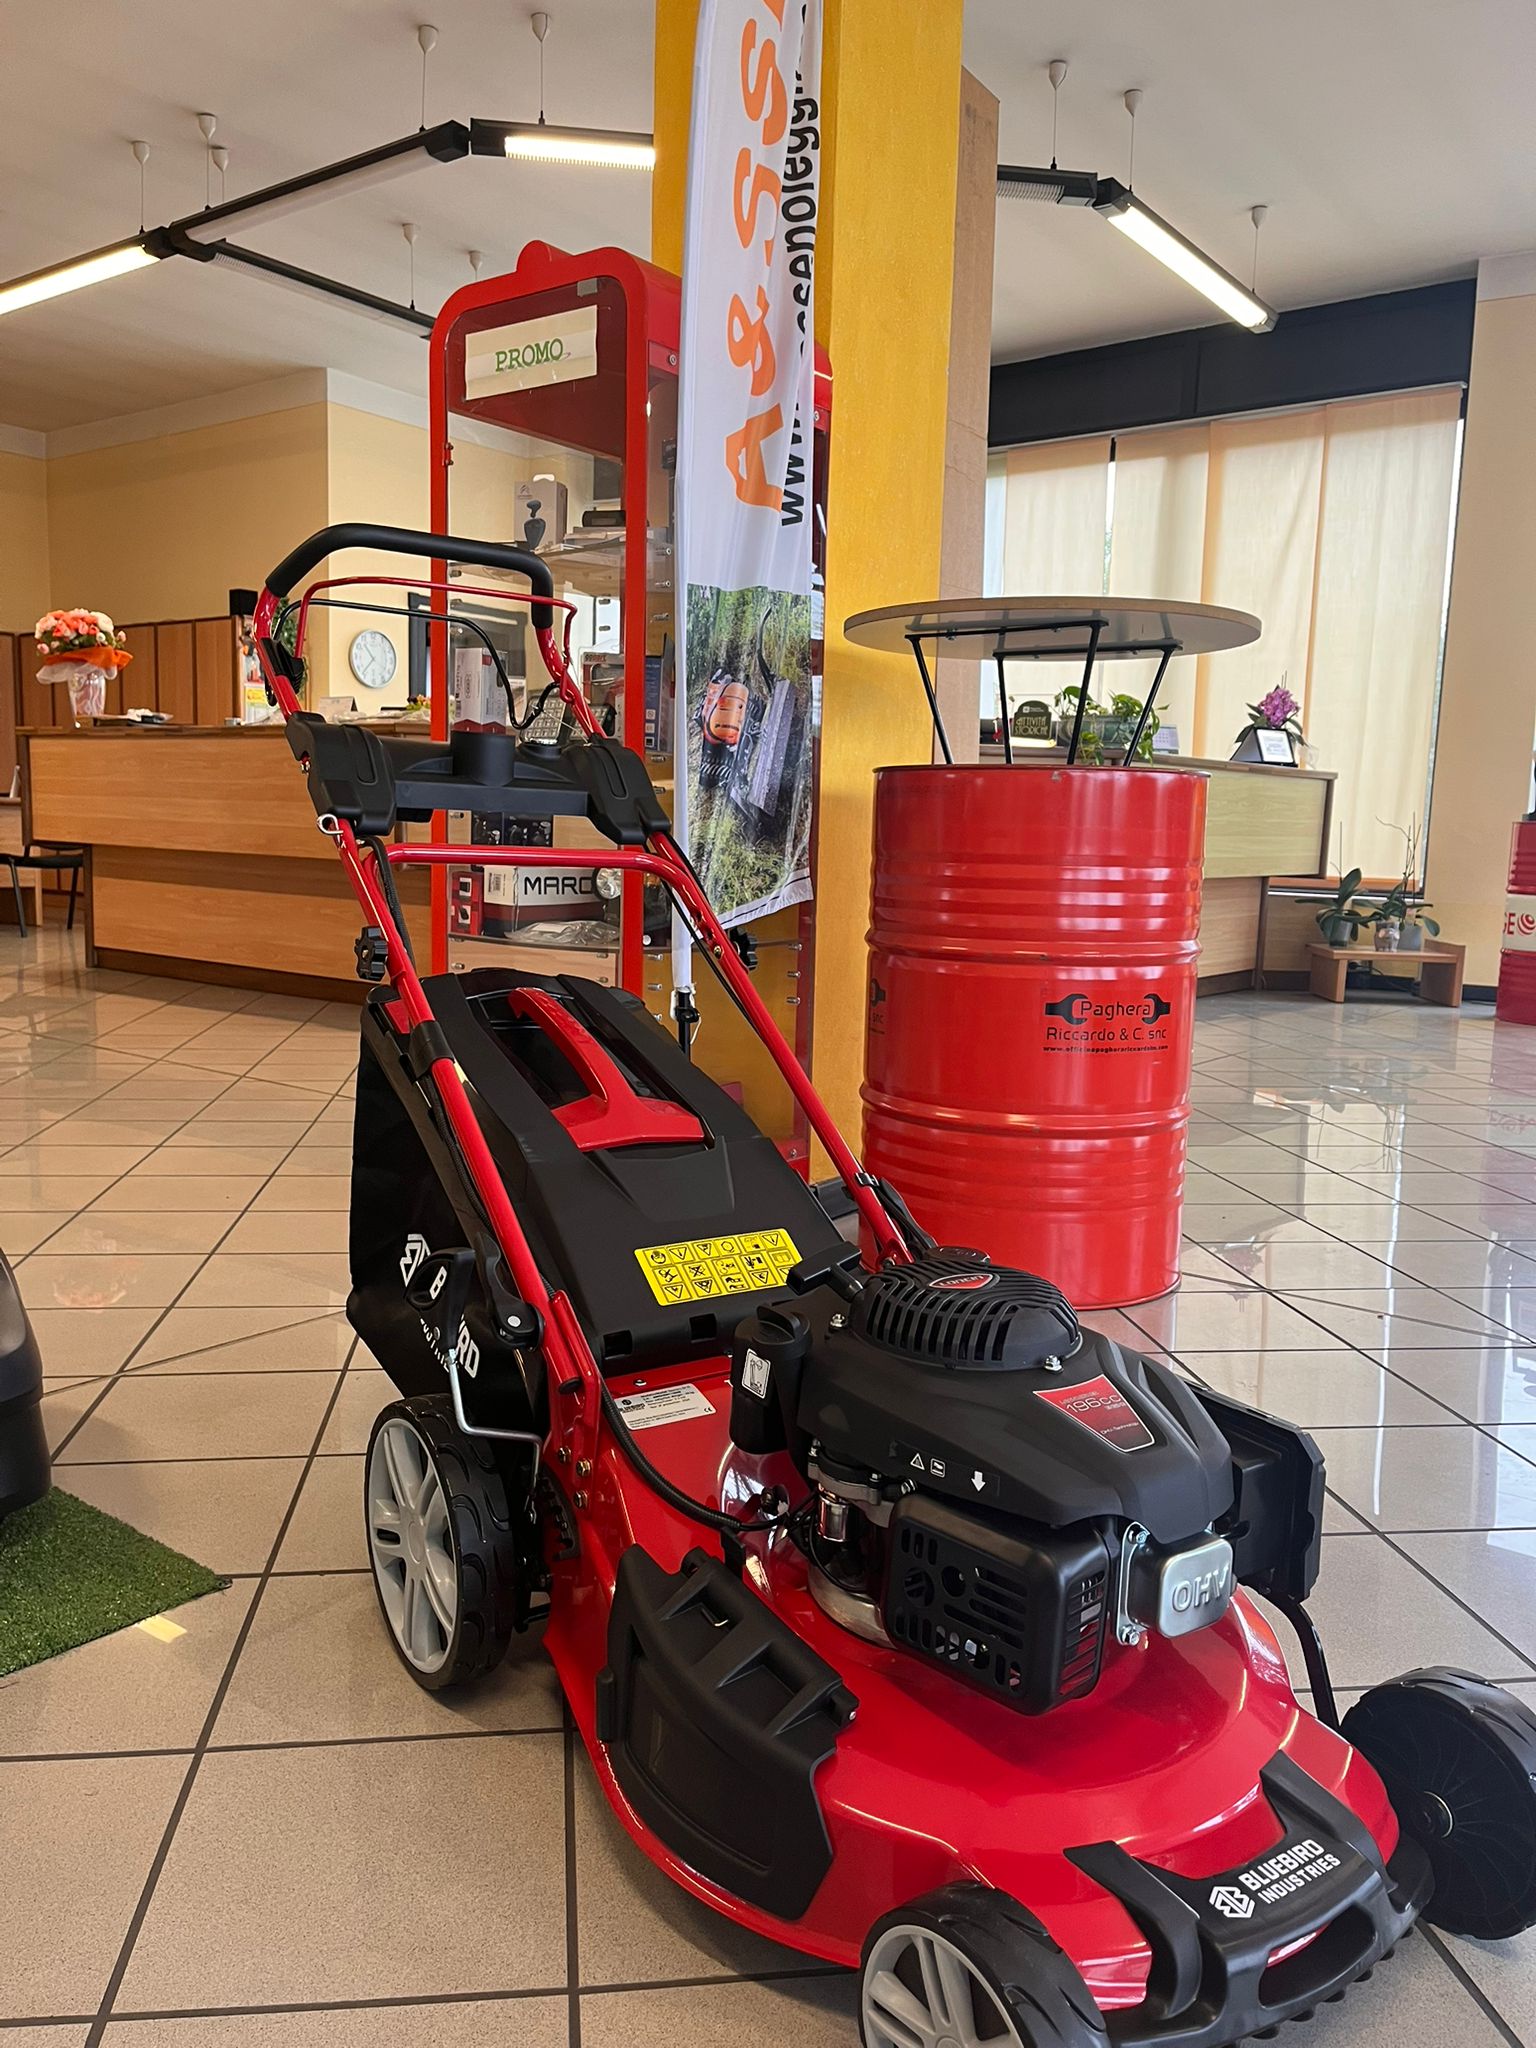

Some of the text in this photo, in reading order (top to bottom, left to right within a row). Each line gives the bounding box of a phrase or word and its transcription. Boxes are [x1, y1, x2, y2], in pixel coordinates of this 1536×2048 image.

[495, 338, 564, 372] PROMO
[1080, 1000, 1151, 1020] Paghera
[1046, 1027, 1168, 1041] Riccardo & C. snc
[1065, 1394, 1122, 1413] 196cc
[1171, 1561, 1231, 1613] OHV
[1238, 1839, 1325, 1891] BLUEBIRD
[1257, 1853, 1342, 1904] INDUSTRIES
